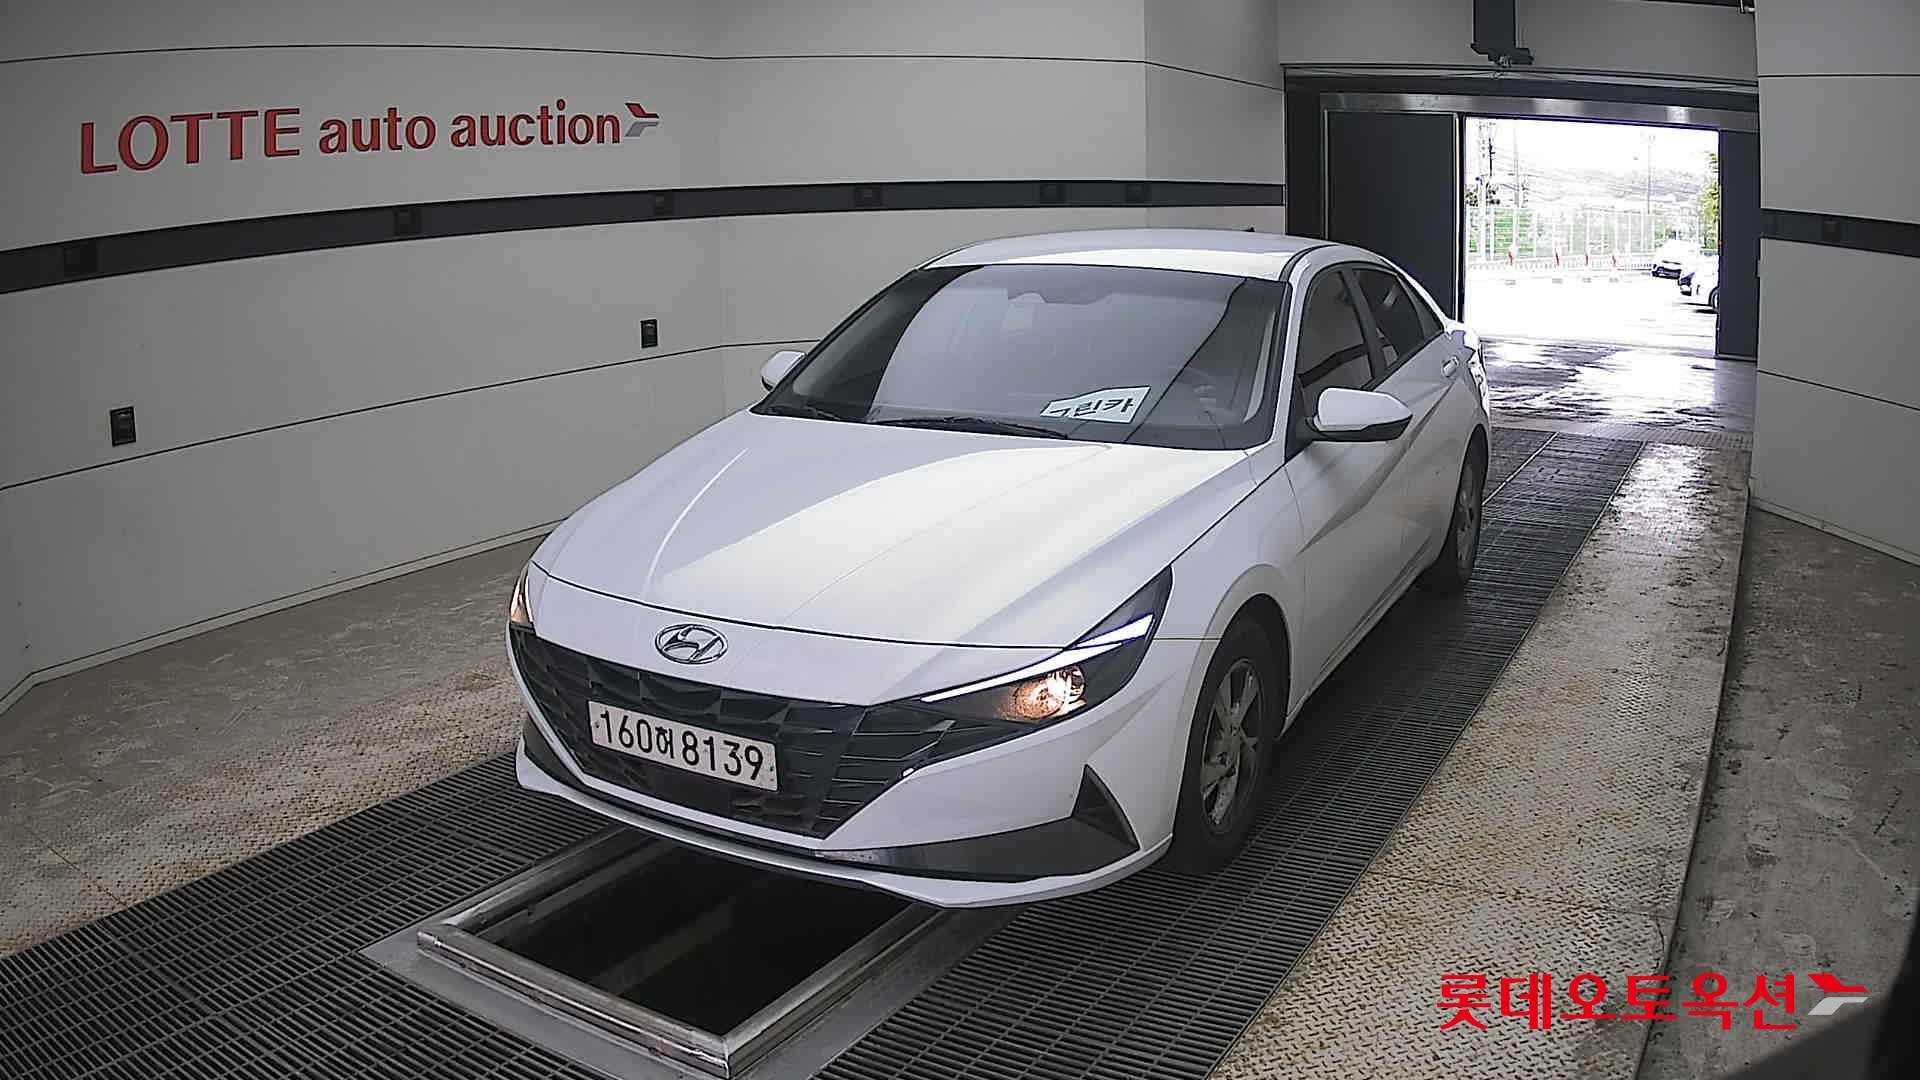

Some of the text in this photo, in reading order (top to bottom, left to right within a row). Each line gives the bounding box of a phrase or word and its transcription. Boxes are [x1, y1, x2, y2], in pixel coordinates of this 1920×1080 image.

[80, 99, 622, 175] LOTTE auto auction
